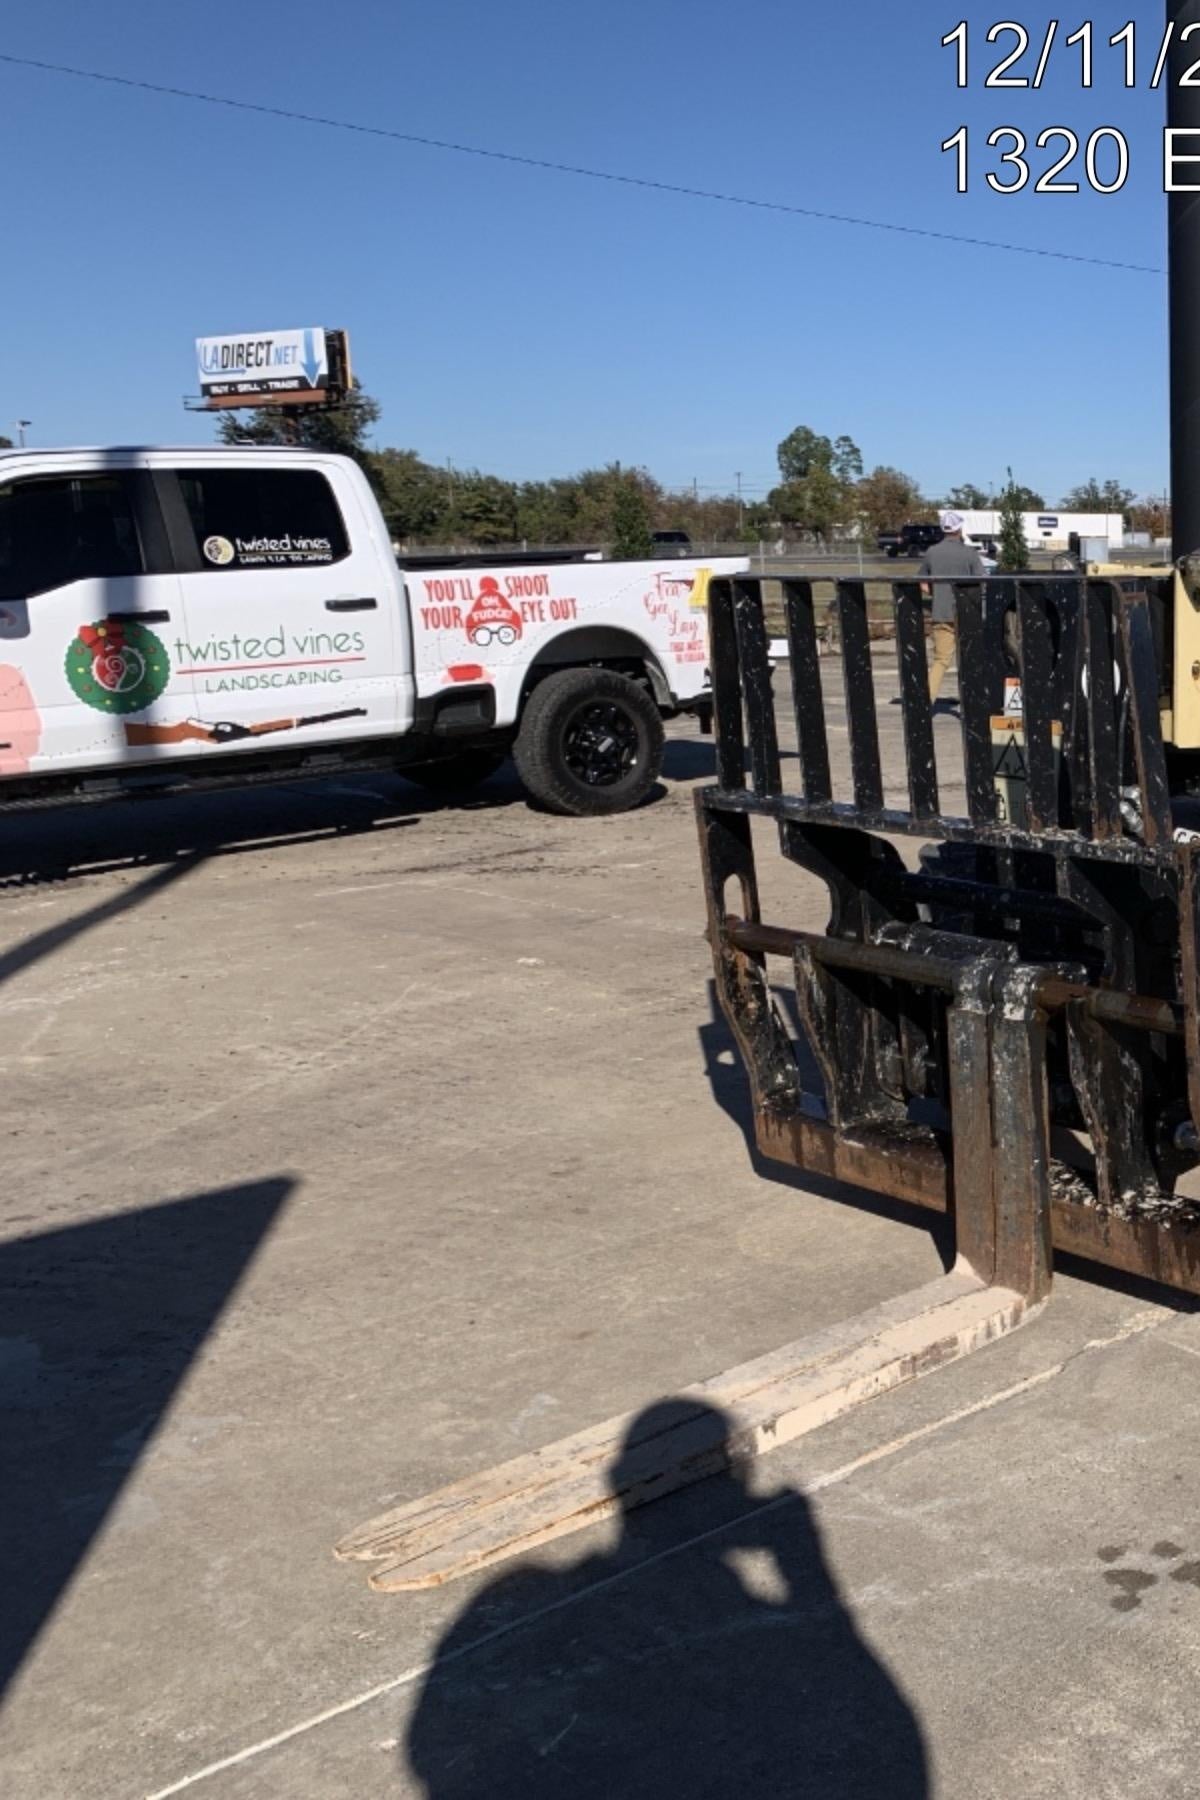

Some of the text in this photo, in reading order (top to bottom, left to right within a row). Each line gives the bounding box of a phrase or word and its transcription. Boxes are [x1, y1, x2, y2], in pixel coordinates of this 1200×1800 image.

[422, 574, 550, 602] YOU'LL SHOOT
[420, 598, 578, 630] YOUR EYE OUT
[174, 625, 366, 664] twisted vines
[205, 668, 344, 694] LANDSCAPING
